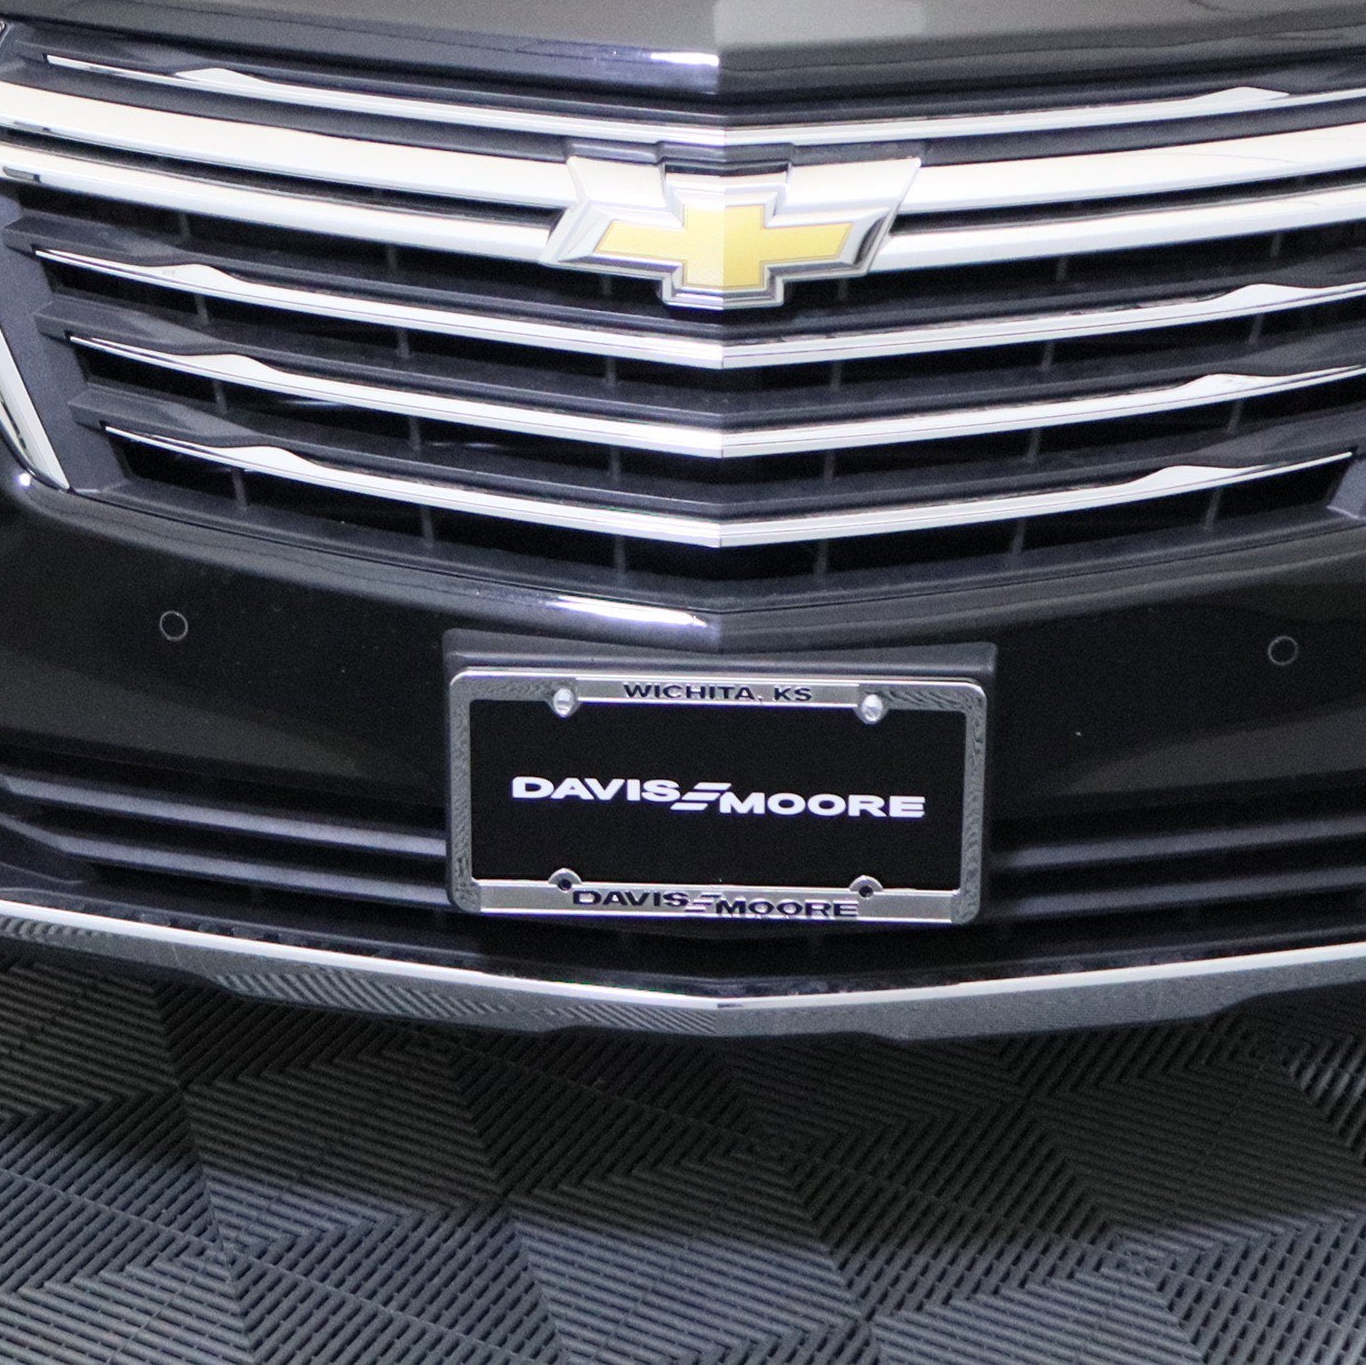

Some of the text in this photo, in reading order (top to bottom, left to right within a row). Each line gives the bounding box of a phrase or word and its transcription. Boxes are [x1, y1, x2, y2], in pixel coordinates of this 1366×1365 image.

[773, 685, 813, 702] KS
[512, 776, 926, 819] DAVIS MOORE
[572, 889, 860, 919] DAVIS MOORE
